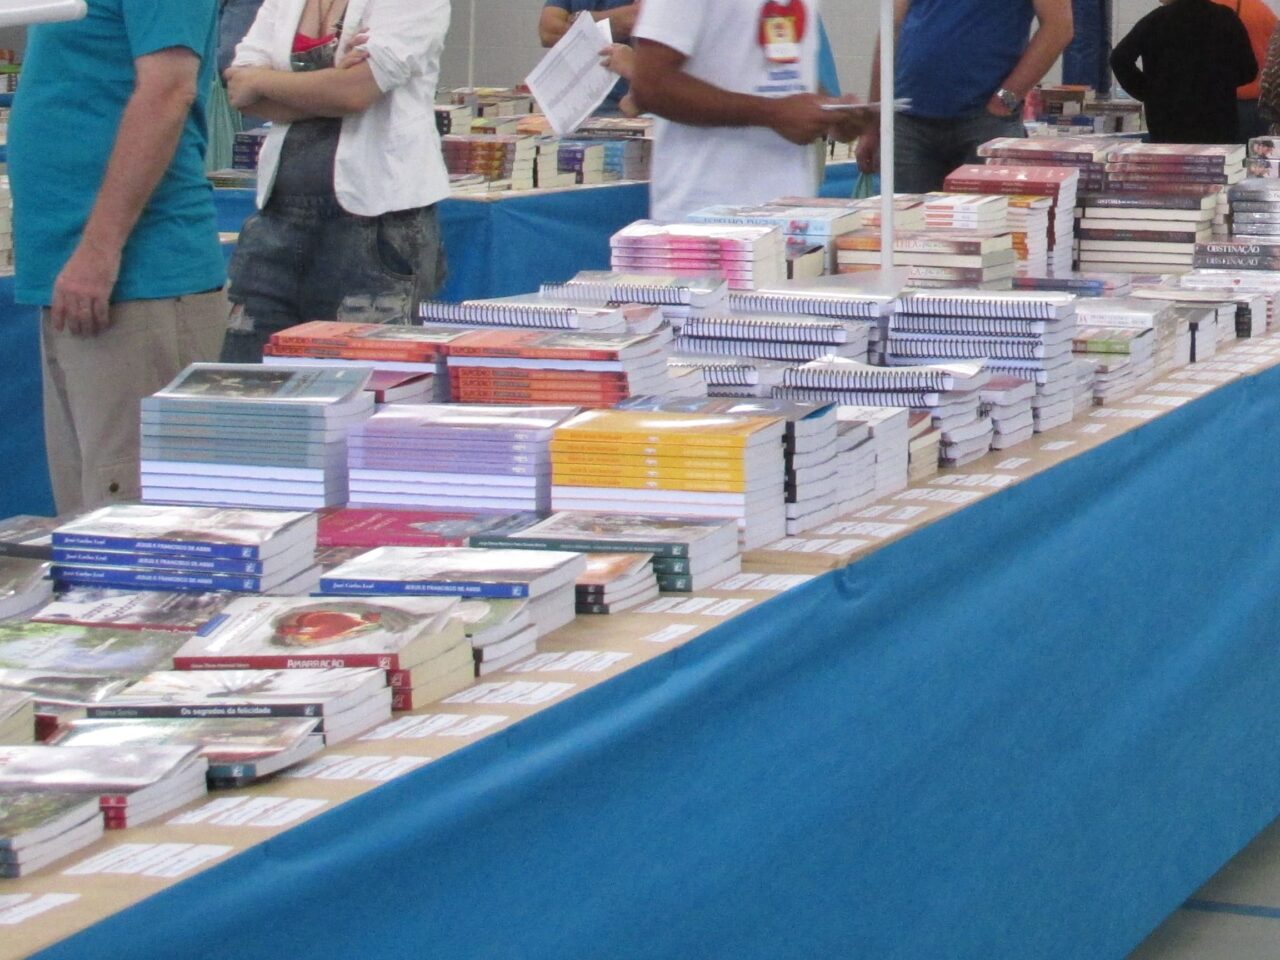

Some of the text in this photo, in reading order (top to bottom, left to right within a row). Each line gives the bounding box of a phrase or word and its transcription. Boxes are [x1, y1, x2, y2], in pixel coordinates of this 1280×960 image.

[181, 707, 191, 715] Os
[193, 708, 225, 716] segredos
[237, 706, 272, 714] felicidade
